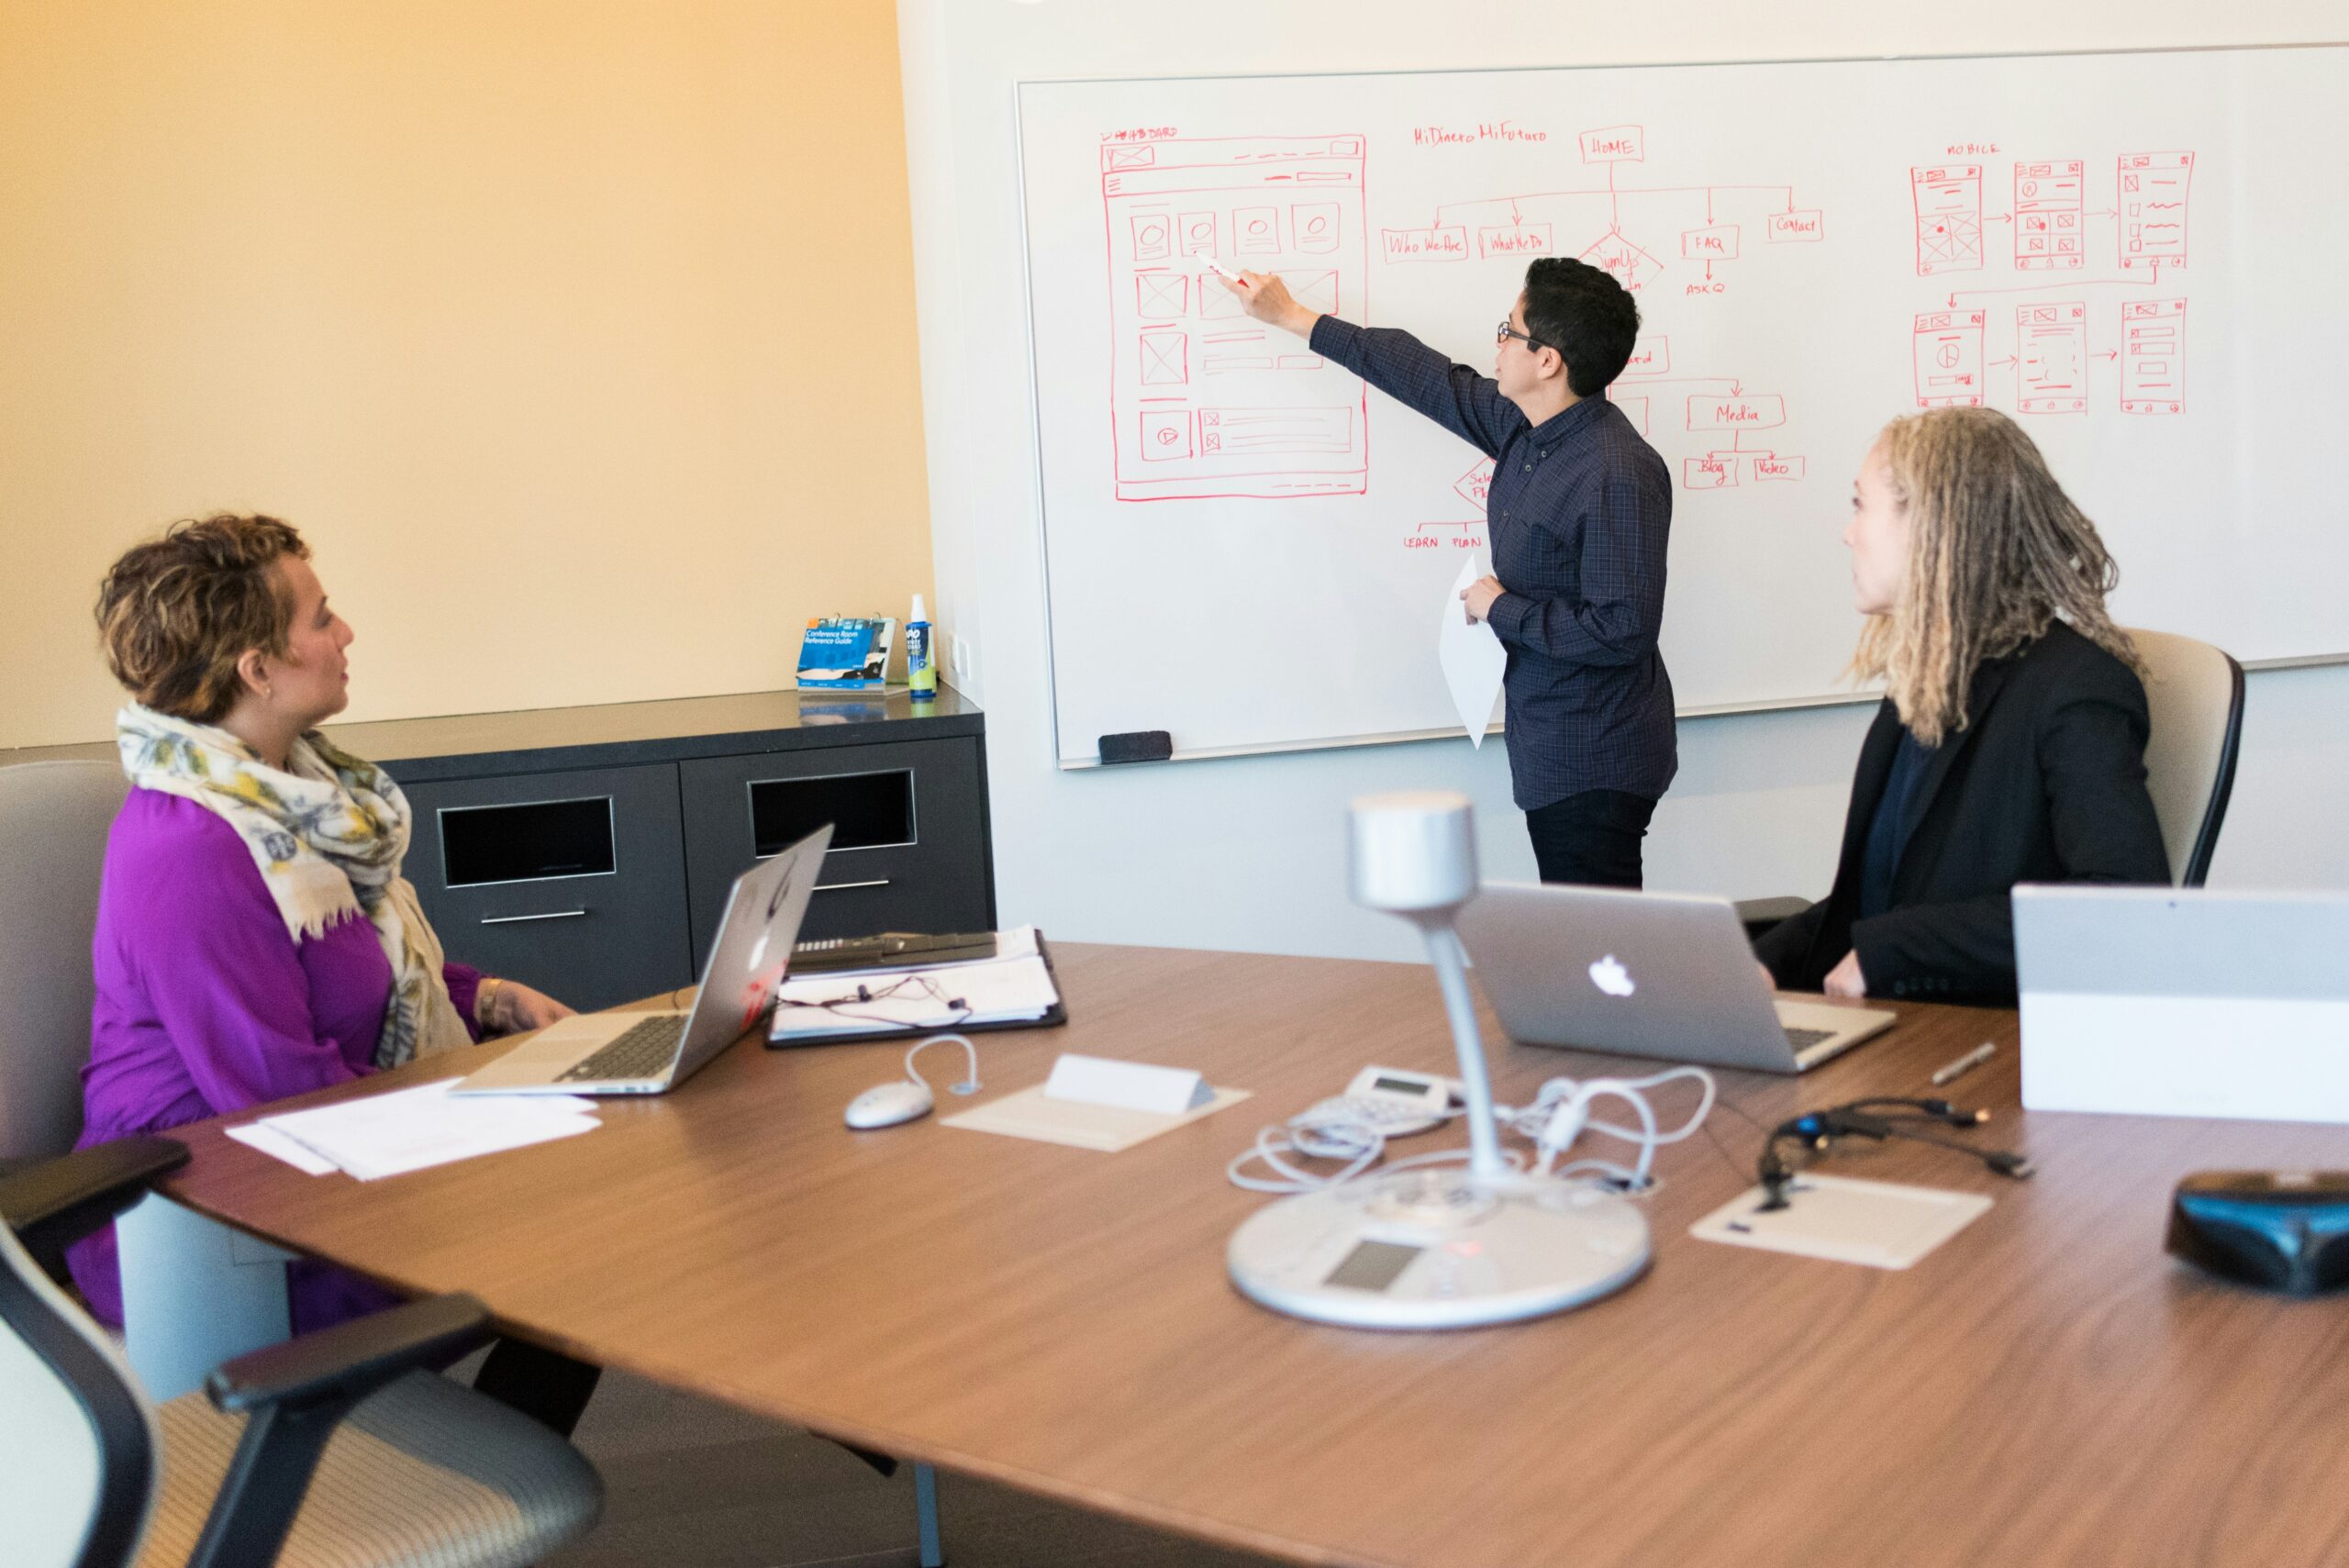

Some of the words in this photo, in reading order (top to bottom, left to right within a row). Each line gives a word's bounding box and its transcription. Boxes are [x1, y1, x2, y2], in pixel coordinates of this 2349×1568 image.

[1776, 217, 1815, 233] Contact
[1389, 233, 1419, 253] Who
[1696, 237, 1724, 253] FAQ
[1687, 284, 1709, 295] ASK
[1712, 283, 1725, 293] Q
[1717, 404, 1759, 423] Media
[1698, 460, 1727, 486] Blog
[1759, 461, 1788, 474] Video
[1469, 472, 1491, 485] Sele
[1403, 537, 1438, 549] LEARN
[1452, 537, 1482, 549] PLAN
[807, 629, 840, 638] Conference
